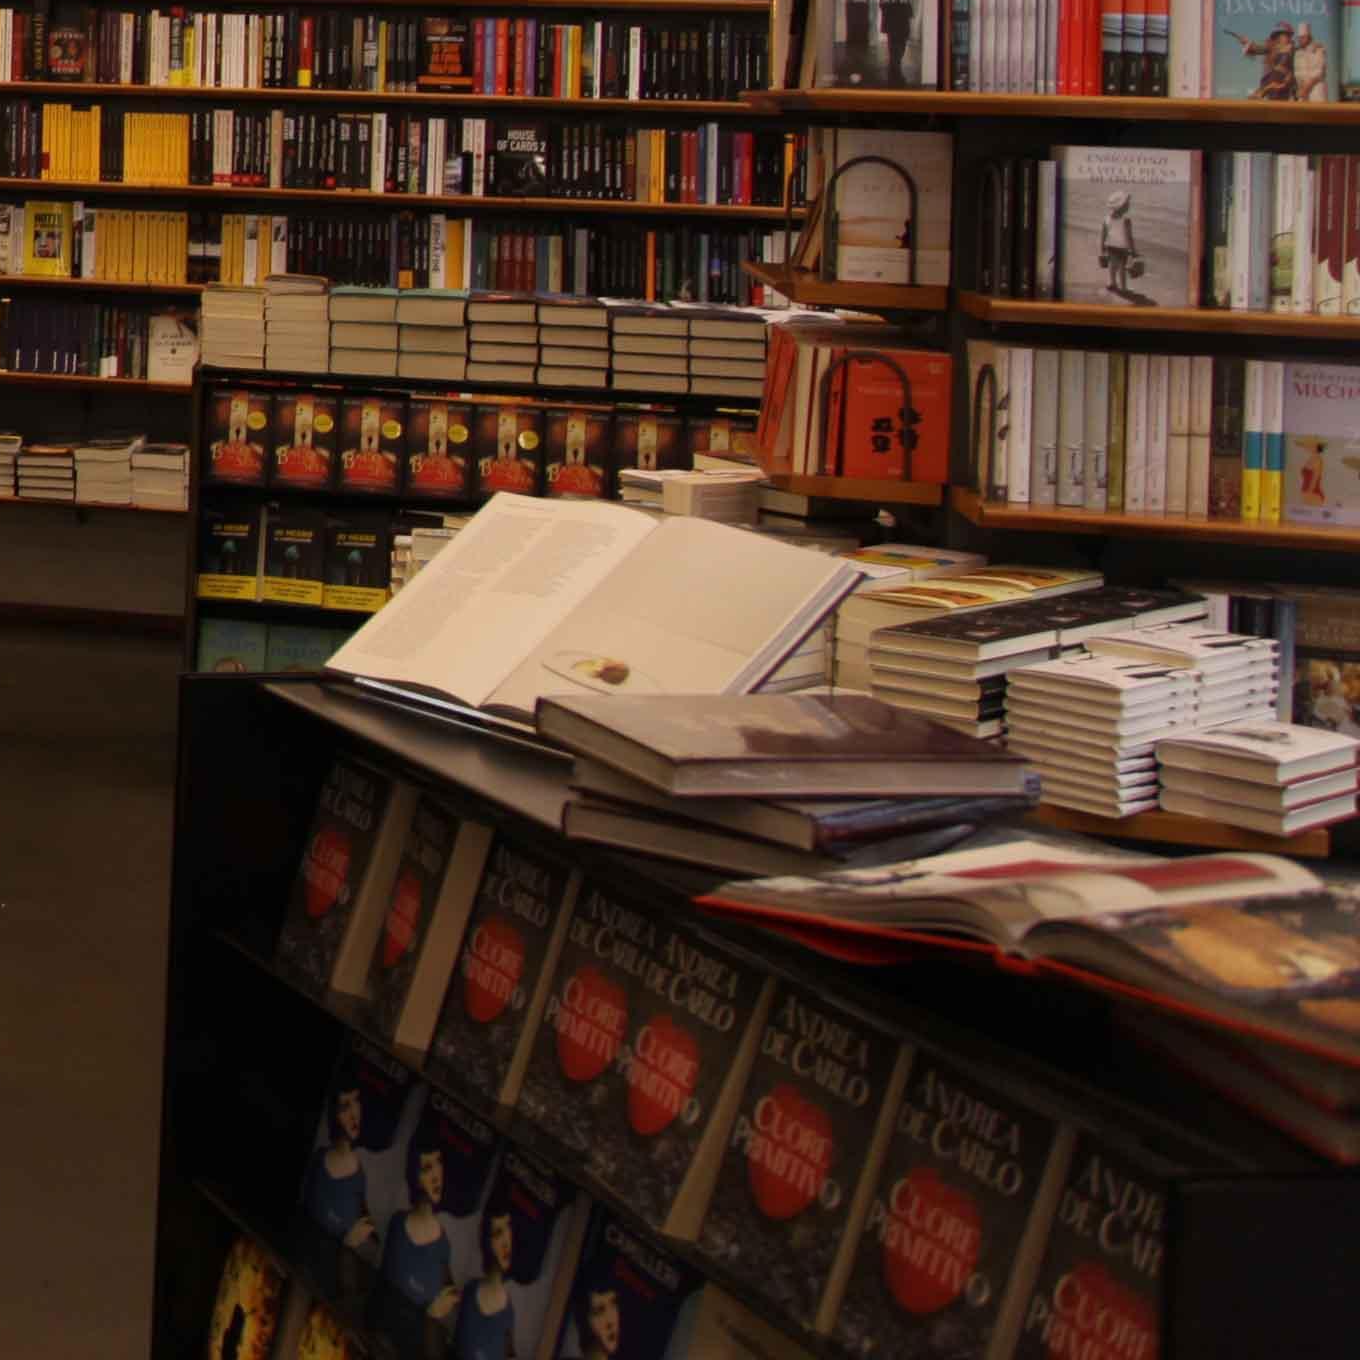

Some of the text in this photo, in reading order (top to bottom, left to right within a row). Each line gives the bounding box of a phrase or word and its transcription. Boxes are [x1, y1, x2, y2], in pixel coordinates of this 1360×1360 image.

[497, 141, 546, 153] OF CARDS 2
[507, 130, 536, 141] HOUSE
[570, 917, 593, 948] DE
[591, 891, 656, 948] ANDREA
[646, 962, 735, 1032] DE CARLO
[667, 932, 739, 998] ANDREA
[544, 994, 621, 1065] PRIMITIV
[563, 975, 628, 1037] CUORE
[782, 995, 869, 1069] ANDREA
[616, 1044, 702, 1126] PRIMITIVO
[635, 1025, 699, 1090] CUORE
[762, 1027, 871, 1107] DE CARLO
[753, 1096, 832, 1168] CUORE
[897, 1102, 1023, 1196] DE CARLO
[920, 1071, 1022, 1156] ANDREA
[731, 1114, 841, 1213] PRIMITIVO
[1080, 1155, 1165, 1232] ANDR
[864, 1198, 991, 1309] PRIMITIVO
[889, 1177, 980, 1265] CUORE
[1058, 1188, 1165, 1280] DE CAR
